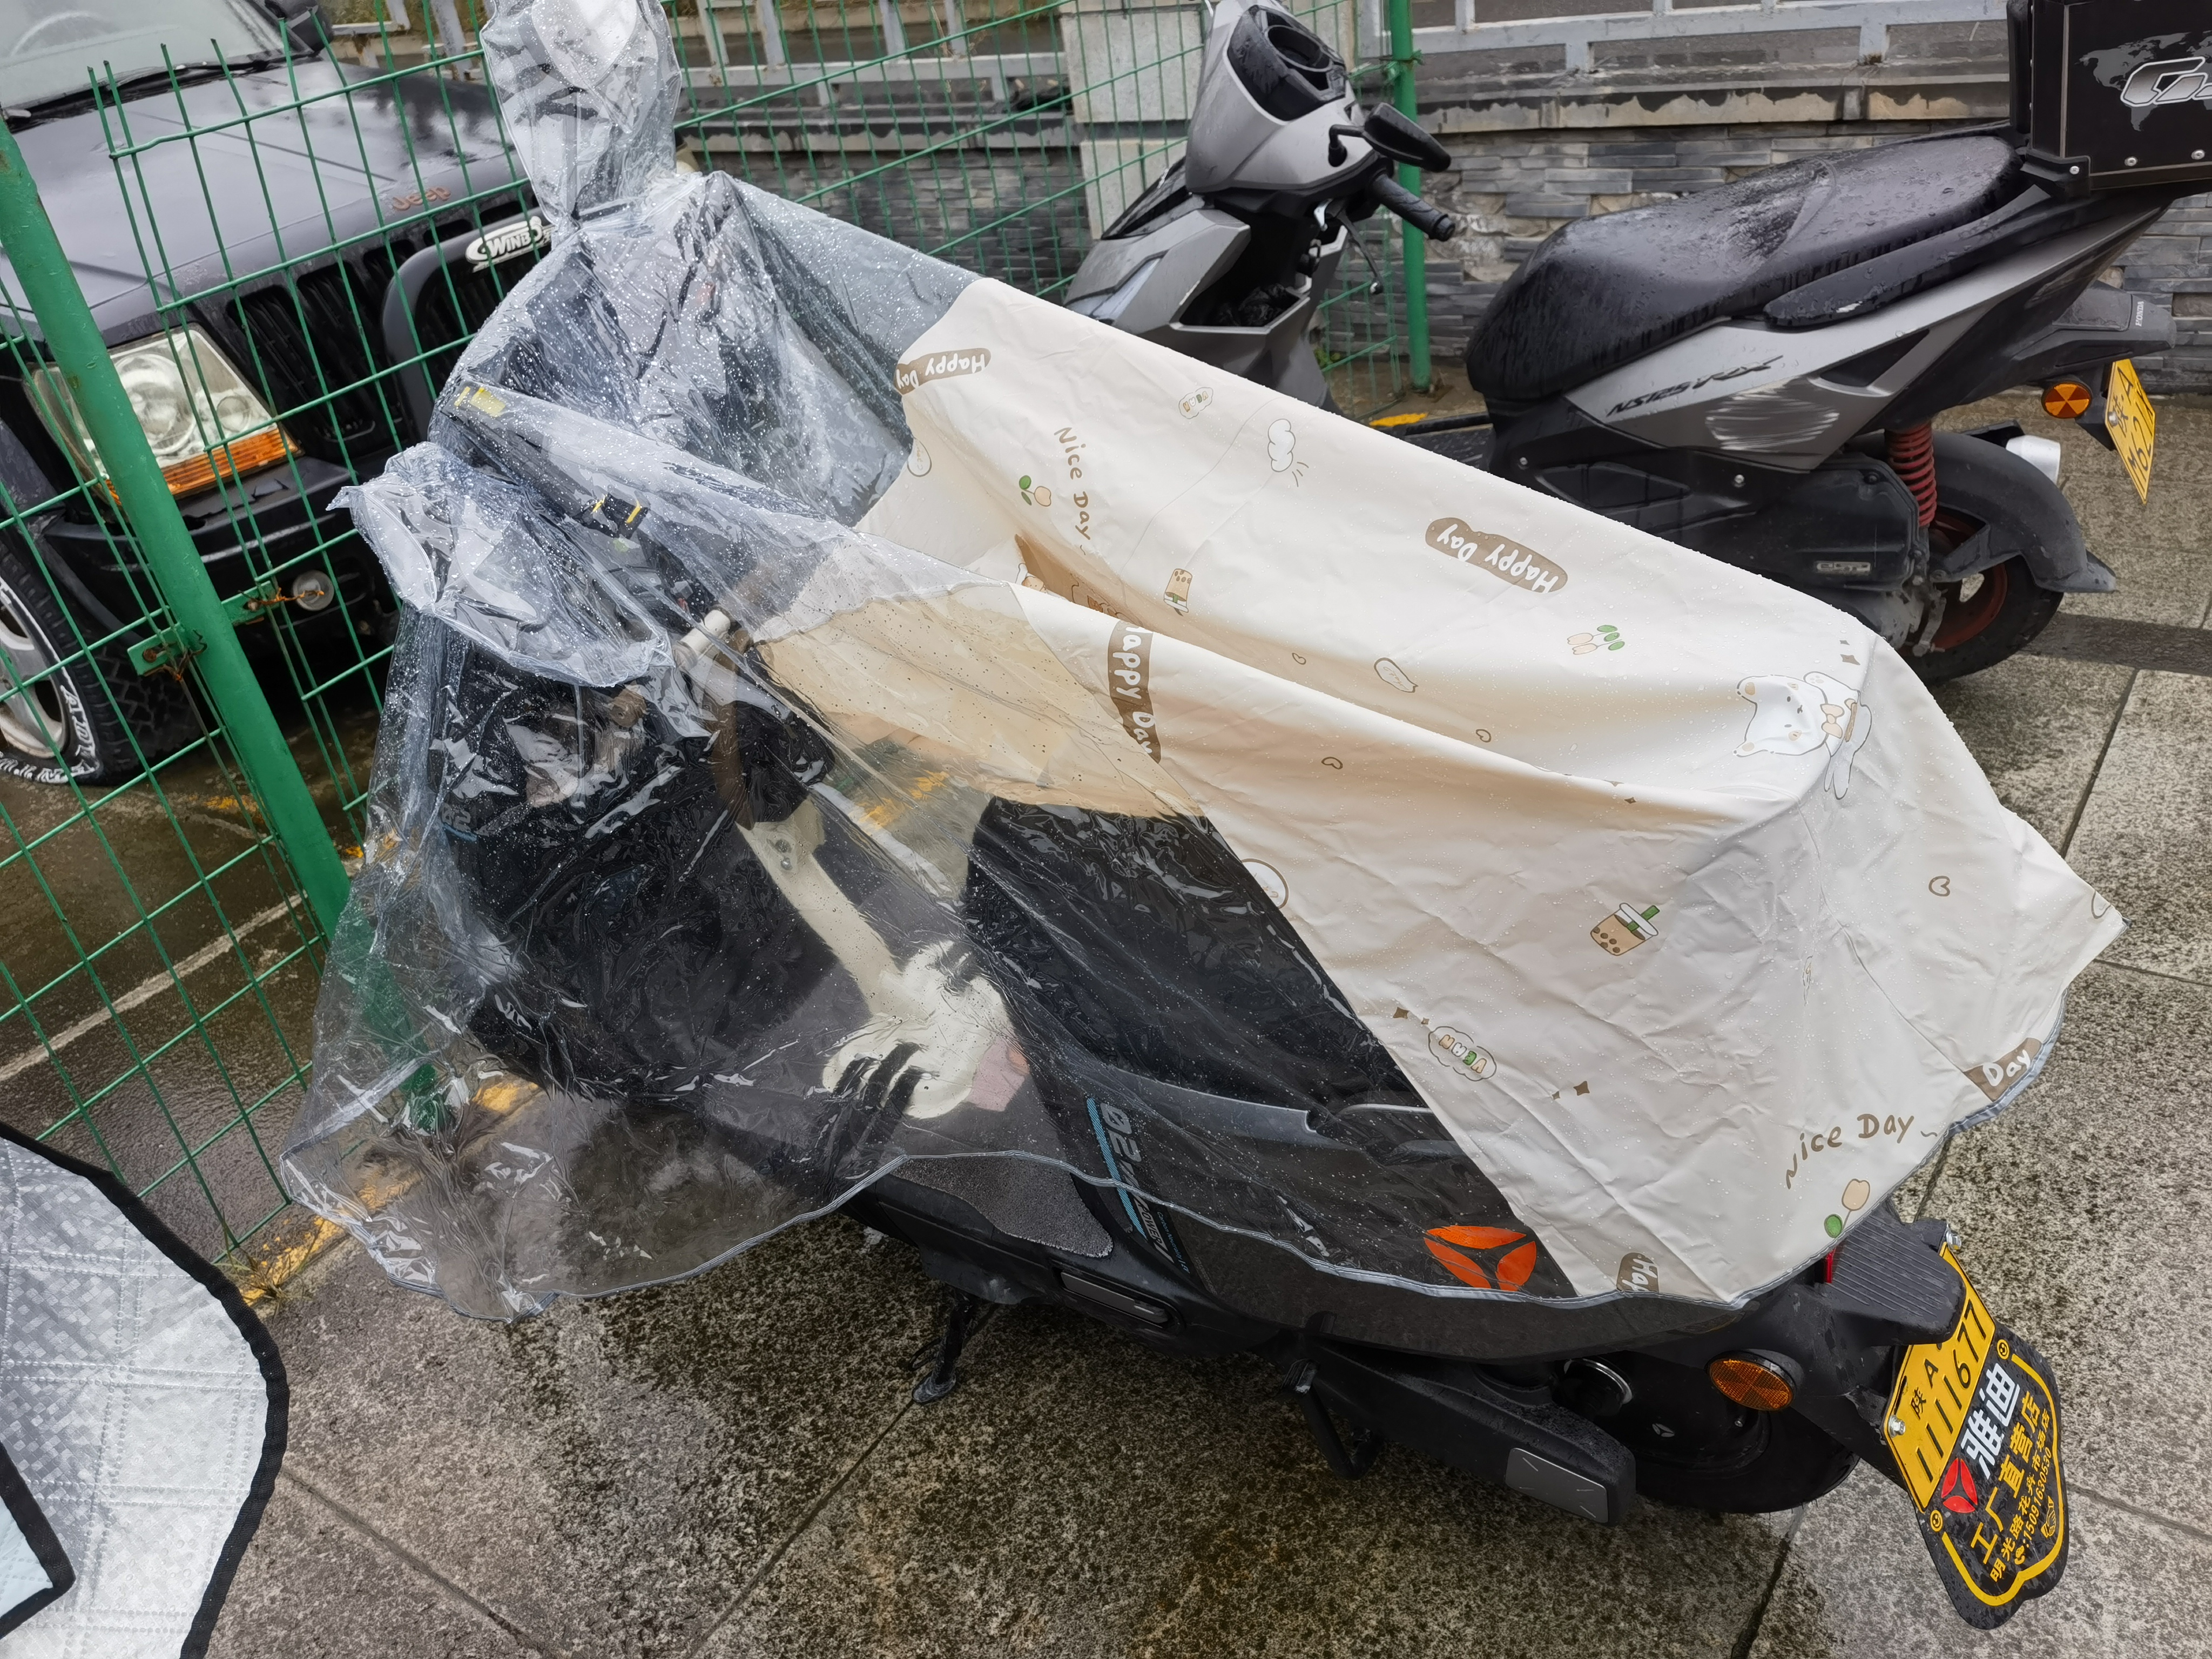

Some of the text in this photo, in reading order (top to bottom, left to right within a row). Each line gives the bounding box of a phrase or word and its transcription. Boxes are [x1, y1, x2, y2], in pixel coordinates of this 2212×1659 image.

[392, 187, 451, 211] Jeep
[2135, 301, 2144, 327] HONDA
[895, 353, 986, 389] Happy Day
[1054, 427, 1085, 480] Nice
[1437, 524, 1558, 594] Happy Day
[1982, 1049, 2031, 1087] Day
[1786, 1126, 1842, 1189] Nice
[1137, 1203, 1163, 1244] POWER
[1157, 1211, 1169, 1233] Carbon
[1913, 1298, 1986, 1482] 1111677
[1961, 1363, 2020, 1479] 雅迪
[1971, 1391, 2041, 1564] 工厂直营店
[1990, 1409, 2049, 1582] 明光路花卉市场店
